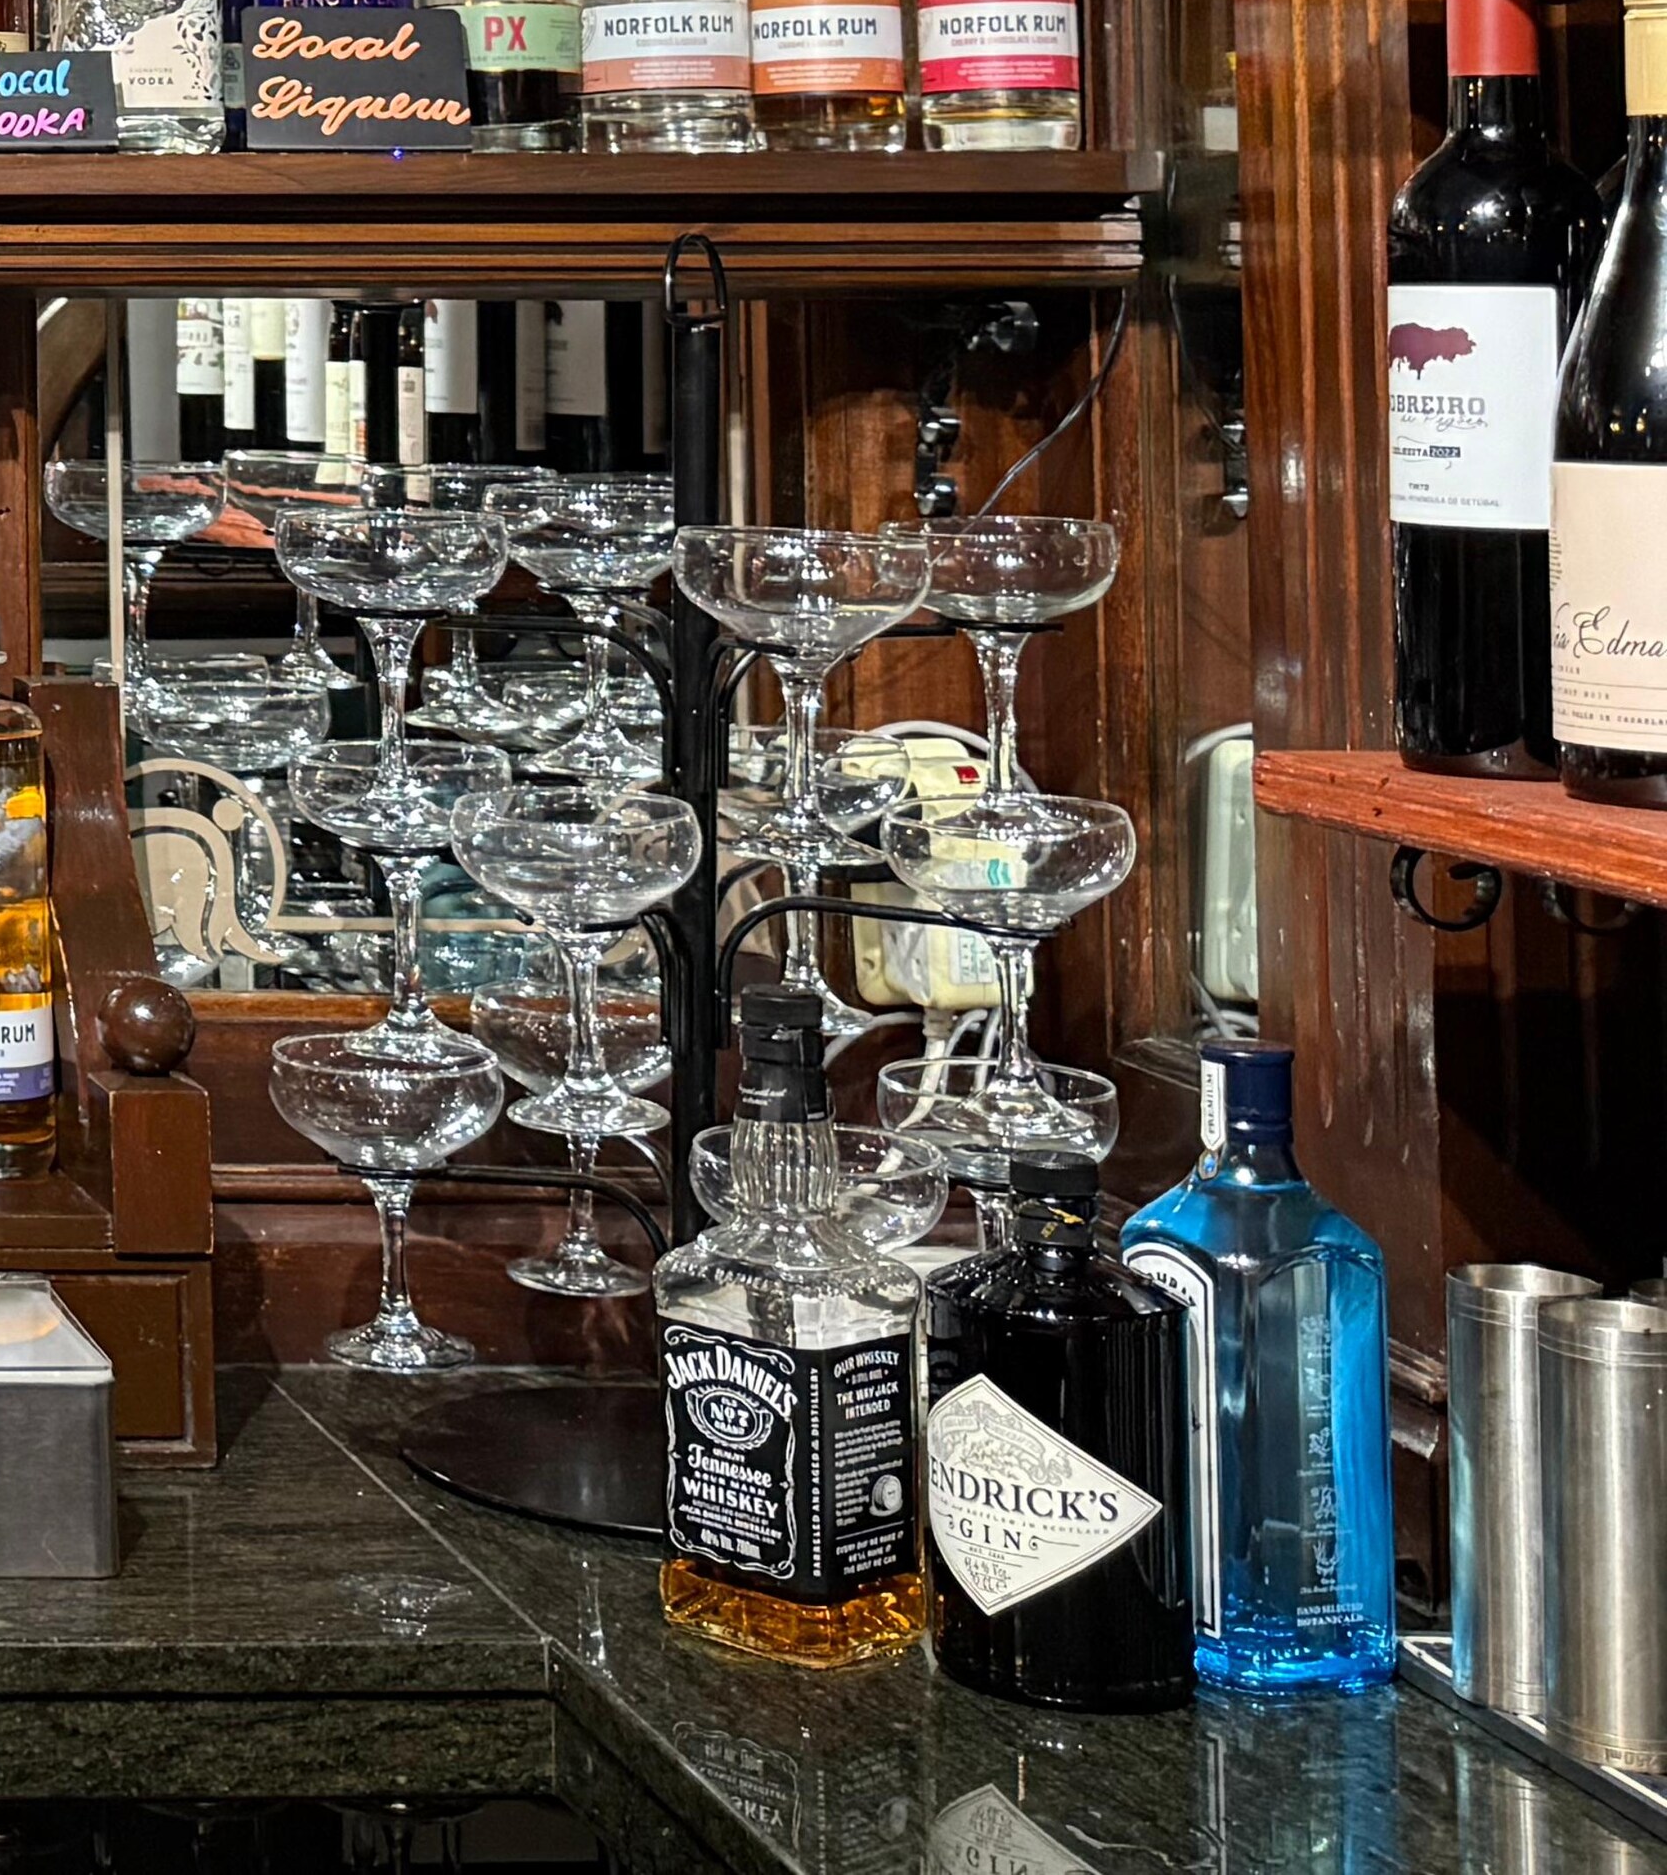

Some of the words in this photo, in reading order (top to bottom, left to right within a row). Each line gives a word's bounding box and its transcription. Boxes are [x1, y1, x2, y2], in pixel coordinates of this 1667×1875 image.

[252, 17, 420, 61] Local
[484, 16, 527, 52] PX
[604, 15, 693, 37] NORFOLK
[700, 15, 734, 33] RUM
[754, 18, 831, 40] NORFOLK
[838, 18, 877, 35] RUM
[939, 15, 1027, 35] NORFOLK
[1033, 15, 1066, 32] RUM
[129, 77, 174, 85] VODKA
[252, 76, 471, 136] Liqueur
[1, 1023, 35, 1043] RUM
[1206, 1073, 1215, 1135] PREMIUM
[834, 1356, 855, 1378] OUR
[856, 1350, 900, 1367] WHISKEY
[665, 1350, 716, 1389] JACK
[716, 1345, 798, 1423] DANIEL'S
[836, 1392, 854, 1406] THE
[856, 1386, 875, 1402] WAY
[875, 1381, 899, 1398] JACK
[810, 1368, 819, 1436] DISTILLERY
[846, 1399, 891, 1420] INTENDED
[688, 1443, 772, 1488] Tennessee
[811, 1453, 820, 1484] AGED
[683, 1476, 779, 1519] WHISKEY
[812, 1487, 821, 1518] AND
[930, 1454, 1119, 1523] ENDRICK'S
[959, 1517, 1021, 1551] GIN
[1043, 1525, 1110, 1535] SCOTLAND
